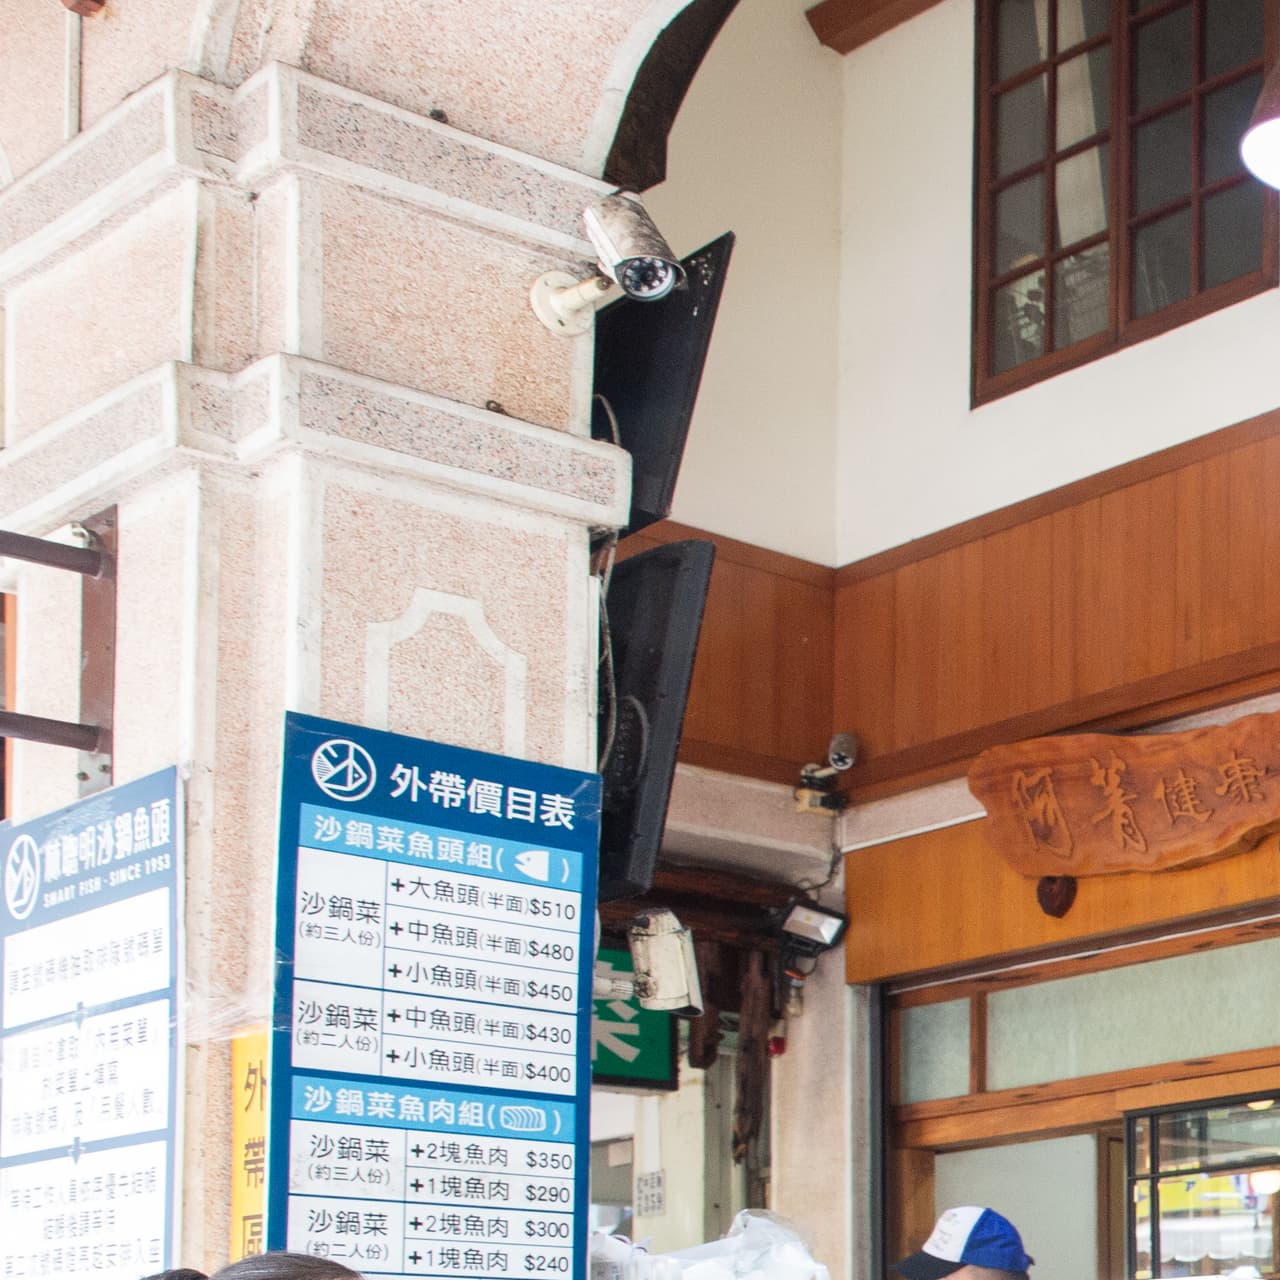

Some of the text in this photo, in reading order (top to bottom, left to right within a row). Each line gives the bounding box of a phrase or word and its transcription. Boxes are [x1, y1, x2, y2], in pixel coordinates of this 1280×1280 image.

[389, 763, 576, 832] 外帶價目表
[43, 854, 171, 909] SMART FISH SINCE 1953
[301, 891, 381, 926] 沙鍋菜
[297, 999, 379, 1032] 沙鍋菜
[309, 1134, 390, 1163] 沙鍋菜
[525, 1150, 573, 1171] $350
[525, 1184, 571, 1205] $290
[308, 1208, 388, 1237] 沙鍋菜
[524, 1219, 570, 1240] $300
[523, 1254, 569, 1273] $240
